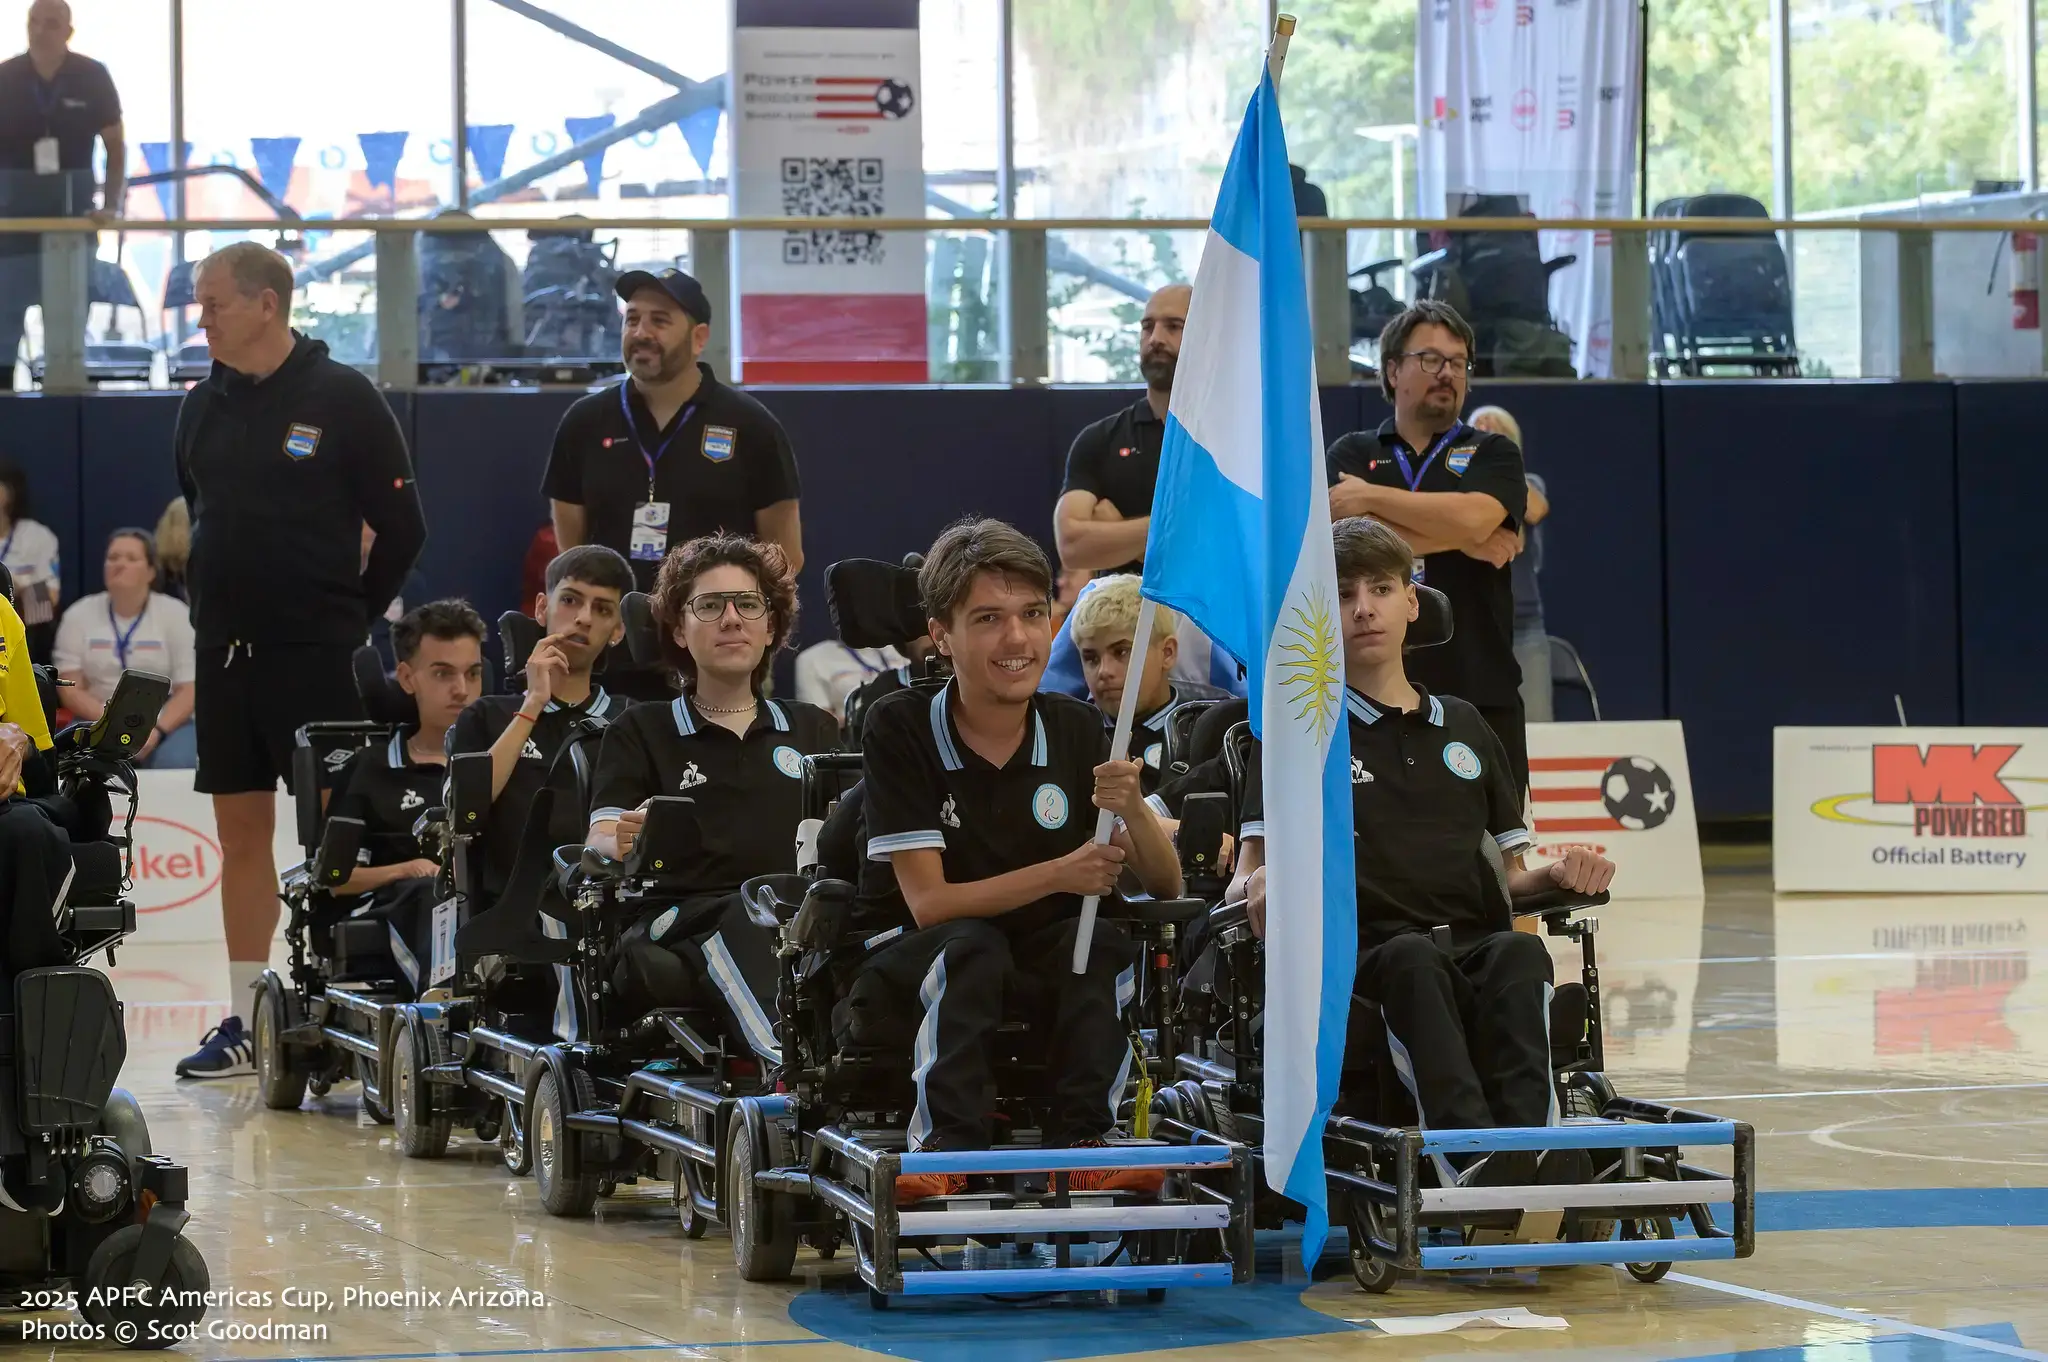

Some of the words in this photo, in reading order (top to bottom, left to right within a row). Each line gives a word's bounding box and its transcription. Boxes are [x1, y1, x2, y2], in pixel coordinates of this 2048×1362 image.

[1872, 743, 2023, 805] MK
[1914, 806, 2027, 837] POWERED
[1872, 846, 1945, 865] Official
[1951, 848, 2027, 868] Battery
